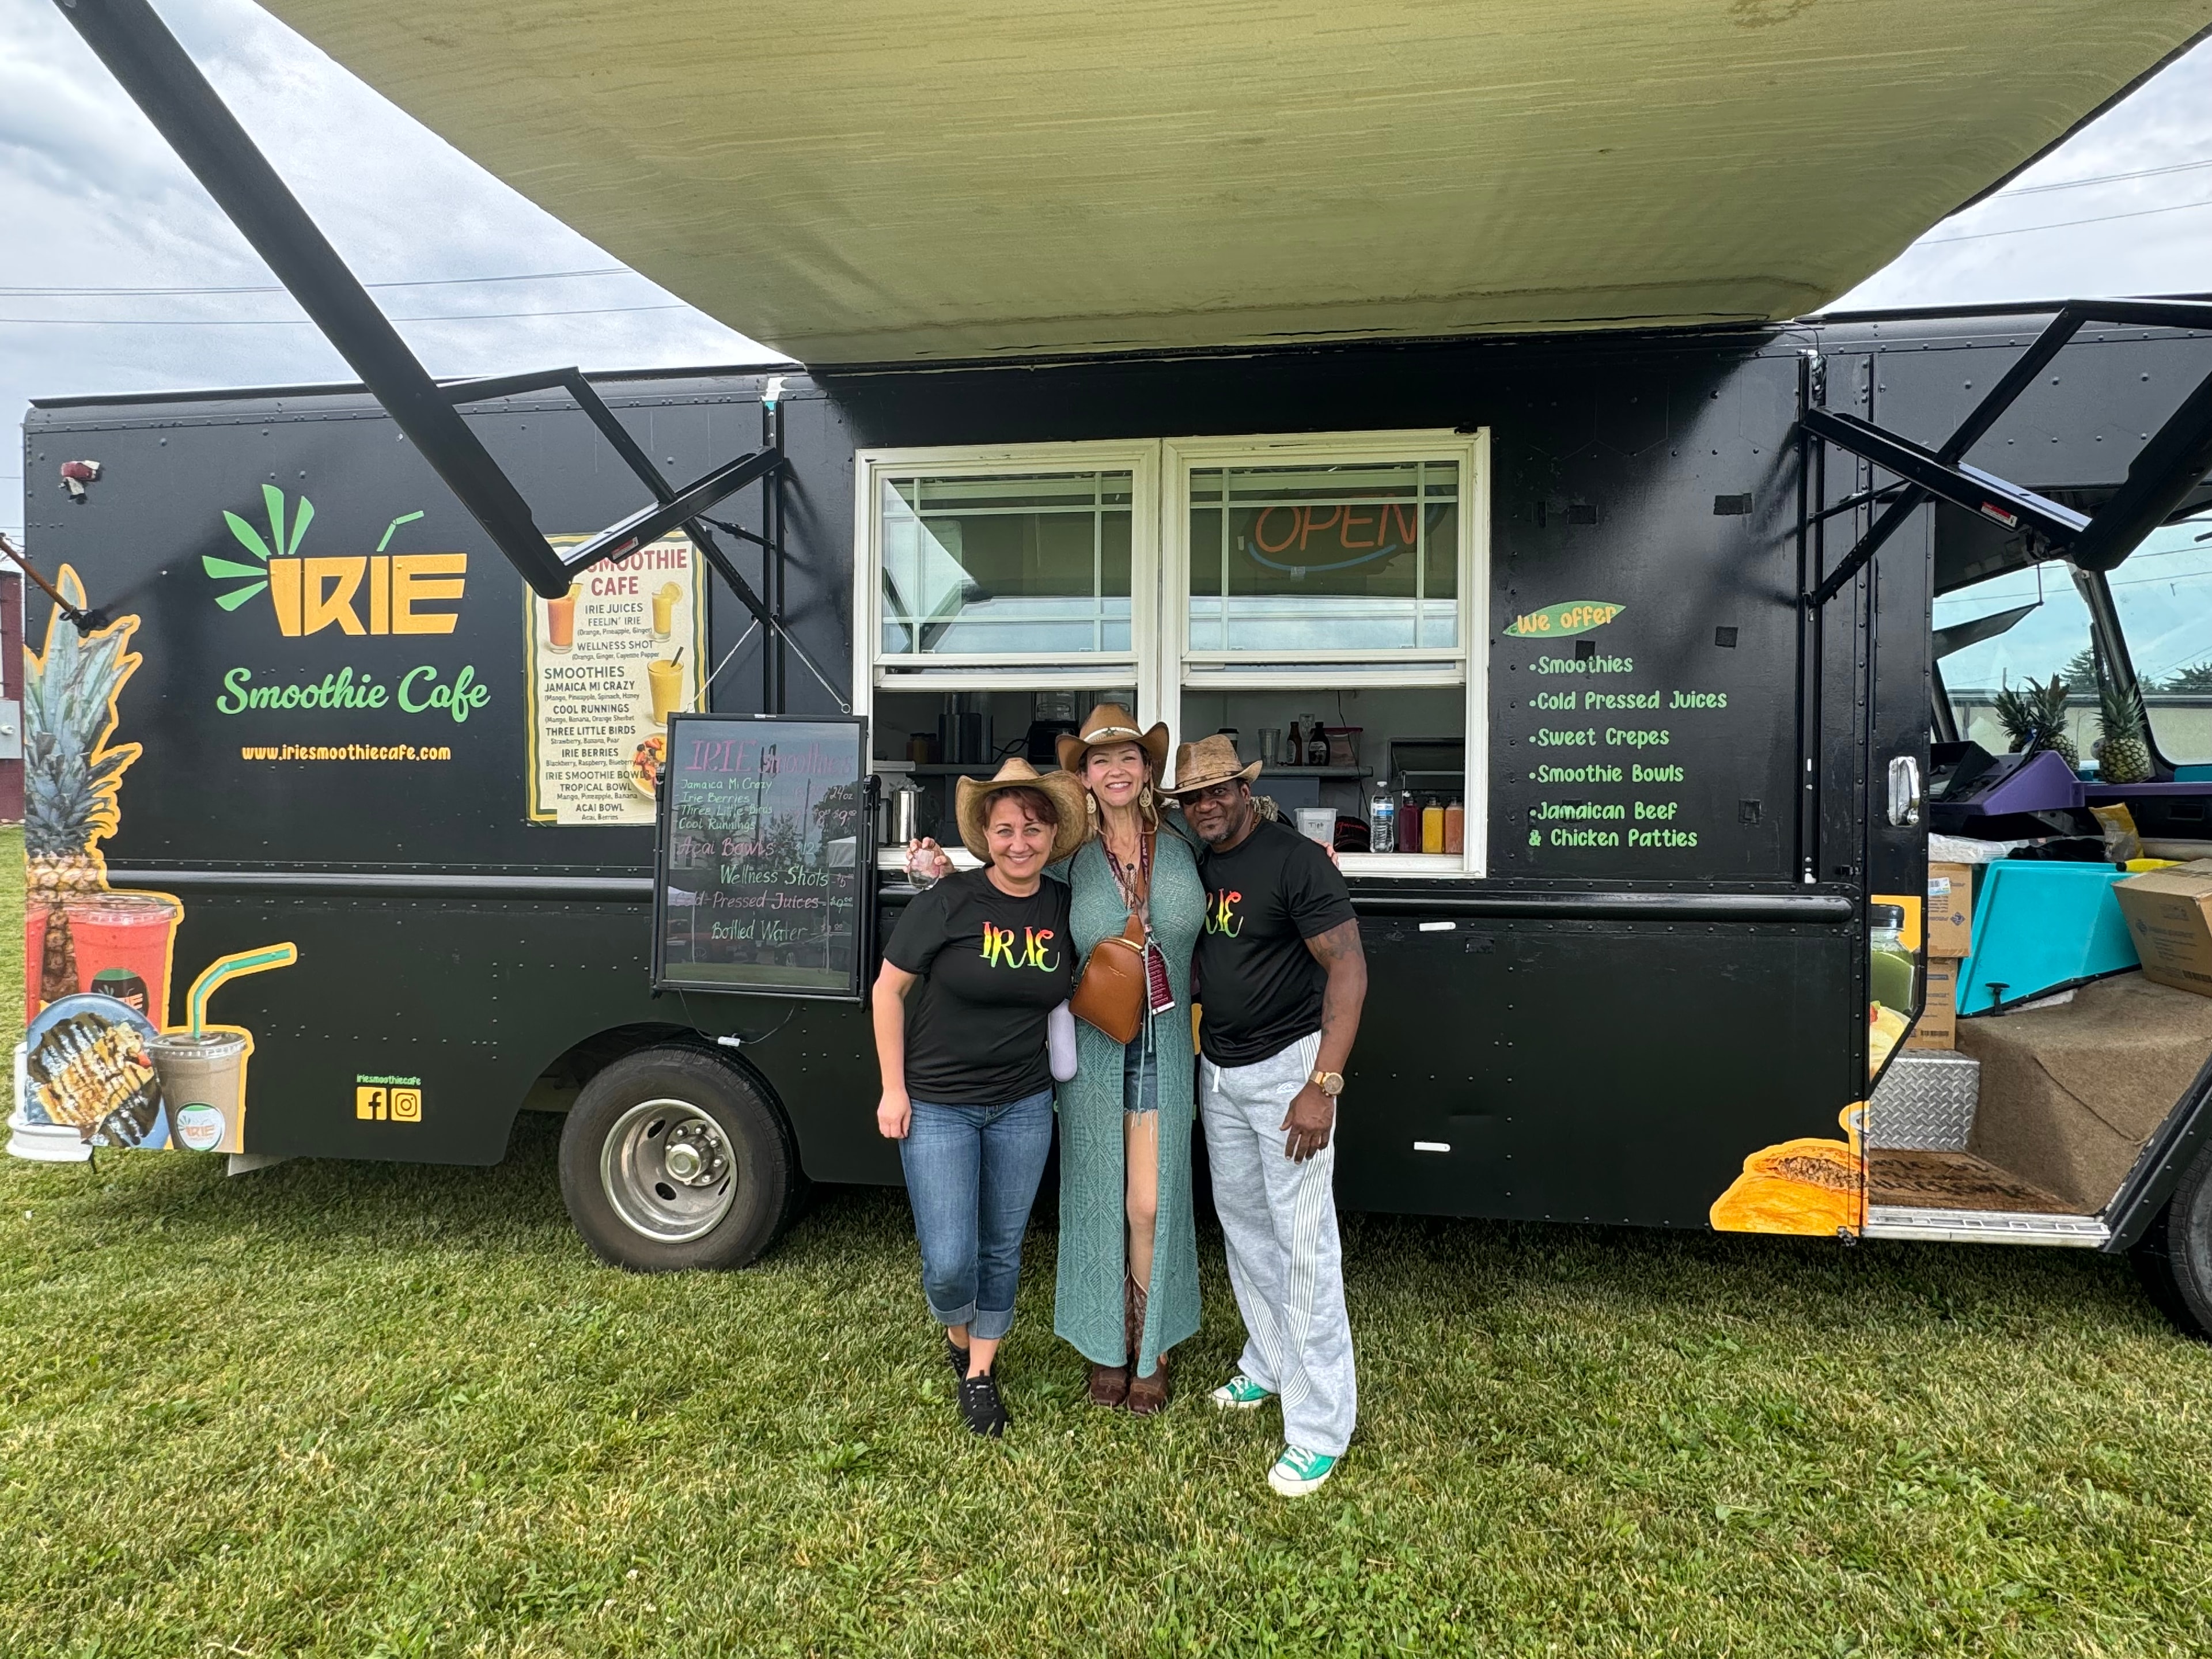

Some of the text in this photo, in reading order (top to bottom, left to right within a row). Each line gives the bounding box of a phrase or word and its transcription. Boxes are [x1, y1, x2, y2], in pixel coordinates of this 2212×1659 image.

[1255, 493, 1418, 552] OPEN
[591, 576, 639, 596] CAFE
[270, 554, 467, 637] IRIE
[585, 603, 643, 614] IRIE JUICES
[624, 616, 641, 625] IRIE
[1517, 605, 1616, 634] We offer
[577, 640, 653, 651] WELLNESS SHOT
[544, 666, 624, 679] SMOOTHIES
[1537, 656, 1633, 674] Smoothies
[217, 665, 490, 723] Smoothie Cafe
[544, 681, 635, 692] JAMAICA MI CRAZY
[1537, 691, 1727, 710] Cold Pressed Juices
[553, 704, 630, 714] COOL RUNNINGS
[546, 726, 636, 736] THREE LITTLE BIRDS
[1537, 728, 1669, 749] Sweet Crepes
[242, 744, 451, 760] www.iriesmoothiecafe.com
[562, 748, 619, 757] IRIE BERRIES
[685, 740, 757, 772] IRIE
[546, 772, 563, 781] IRIE
[565, 771, 615, 780] SMOOTHIE
[1537, 764, 1684, 783] Smoothie Bowls
[560, 783, 632, 791] TROPICAL BOWL
[680, 778, 772, 794] Jamaica Mi Crazy
[680, 791, 750, 804] Irie Berries
[575, 804, 624, 812] ACAI BOWL
[681, 804, 772, 816] Three Little Birds
[1537, 802, 1677, 820] Jamaican Beef
[679, 817, 756, 833] Cool Runnings
[1529, 829, 1698, 847] & Chicken Patties
[721, 837, 775, 857] Bowls
[721, 864, 778, 884] Wellness
[785, 865, 829, 887] Shots
[771, 893, 819, 910] Juices
[1206, 888, 1244, 938] RIE
[711, 919, 756, 940] Bottled
[760, 920, 808, 941] Water
[979, 922, 1060, 972] IRIE
[357, 1074, 421, 1085] iriesmoothiecafe
[185, 1124, 215, 1137] IRIE
